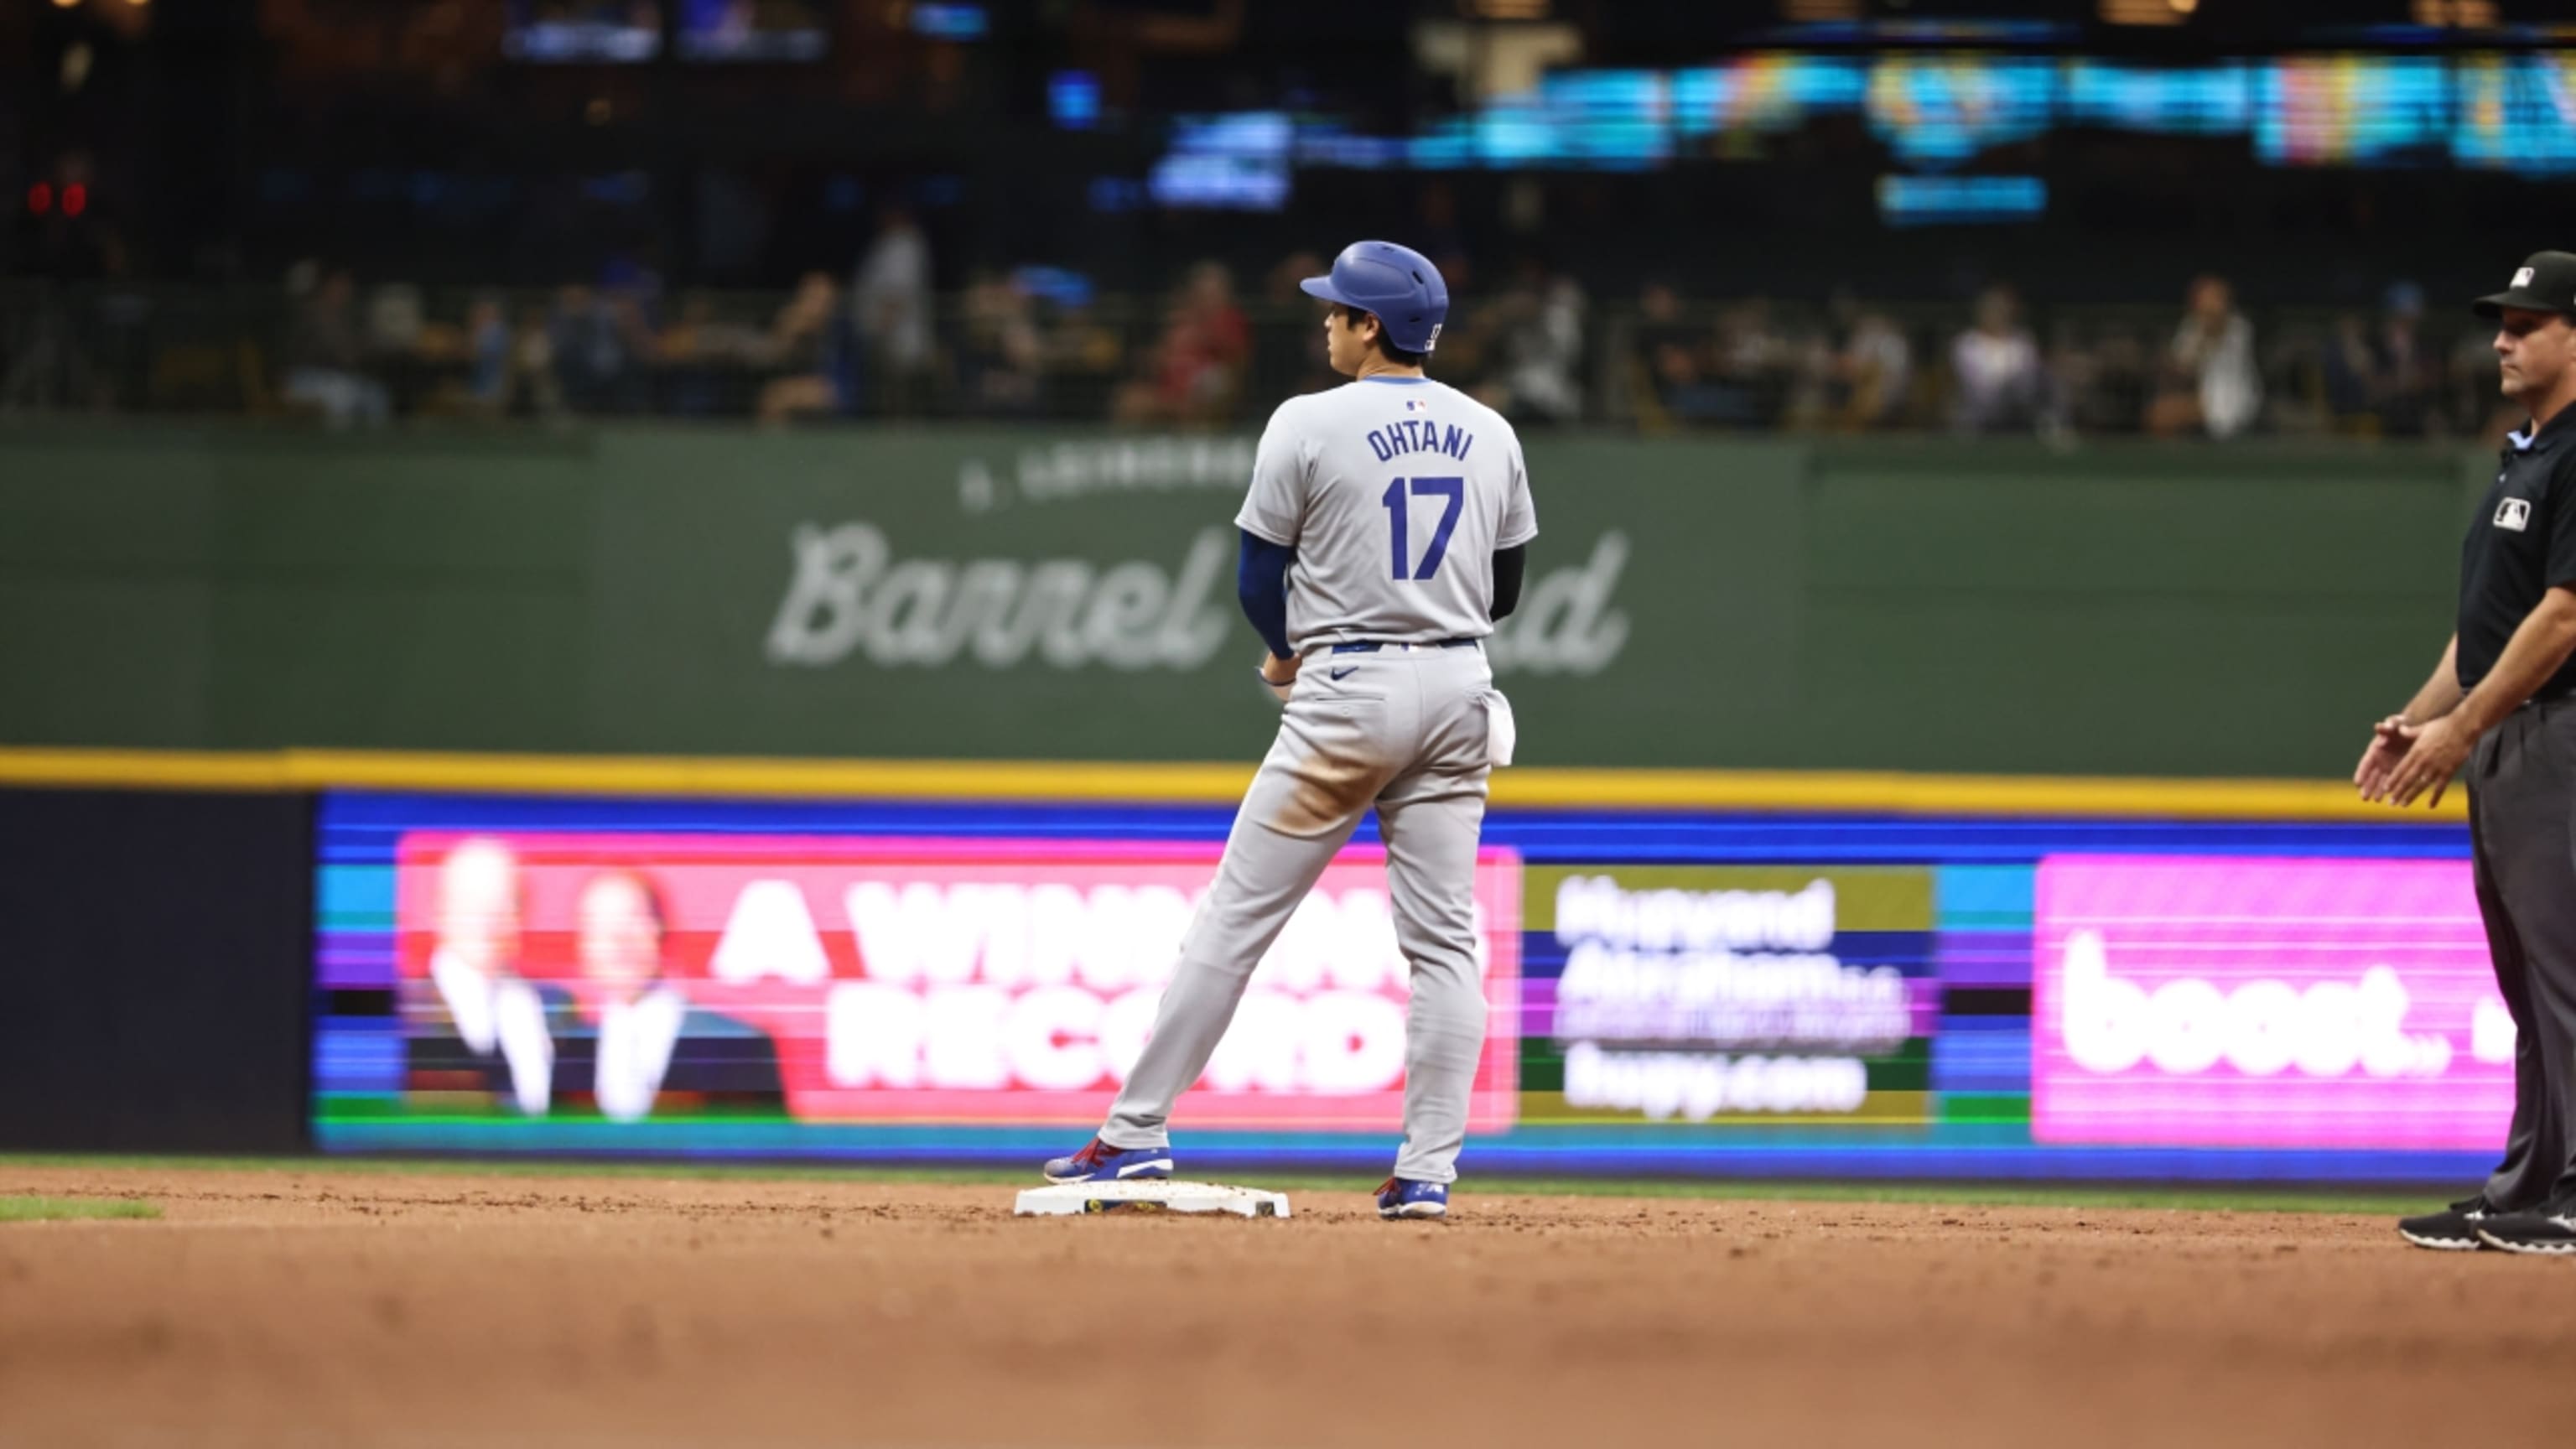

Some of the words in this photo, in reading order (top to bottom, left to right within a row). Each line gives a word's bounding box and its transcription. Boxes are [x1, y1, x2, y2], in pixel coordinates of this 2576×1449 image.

[1367, 419, 1473, 462] OHTANI
[1382, 476, 1464, 580] 17
[769, 523, 1228, 669] Barrel
[717, 880, 827, 983] A
